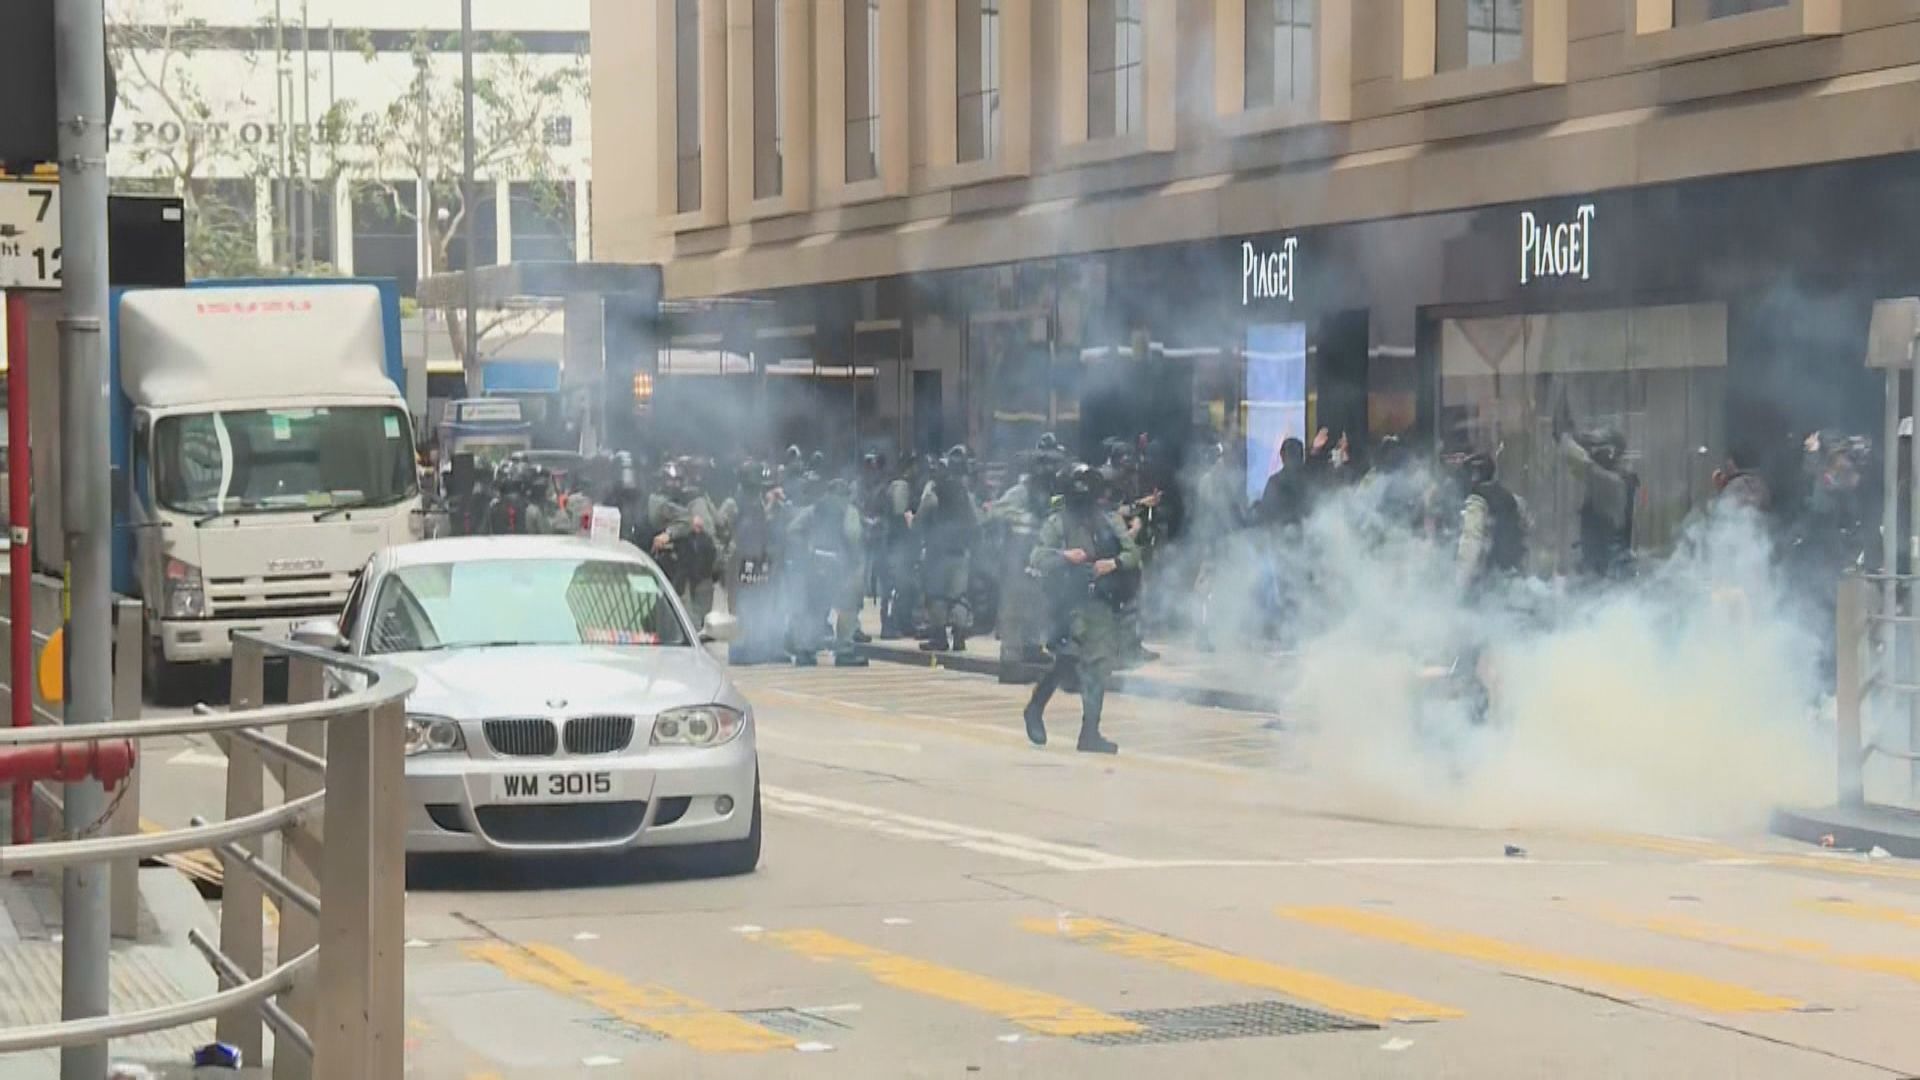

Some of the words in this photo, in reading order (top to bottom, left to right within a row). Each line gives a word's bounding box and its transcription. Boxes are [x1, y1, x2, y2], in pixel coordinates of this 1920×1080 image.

[132, 121, 229, 144] POT
[28, 189, 53, 222] 7
[1520, 204, 1595, 284] PIAGET
[1242, 236, 1297, 305] PIAGET
[503, 775, 538, 797] WM
[548, 772, 610, 795] 3015
